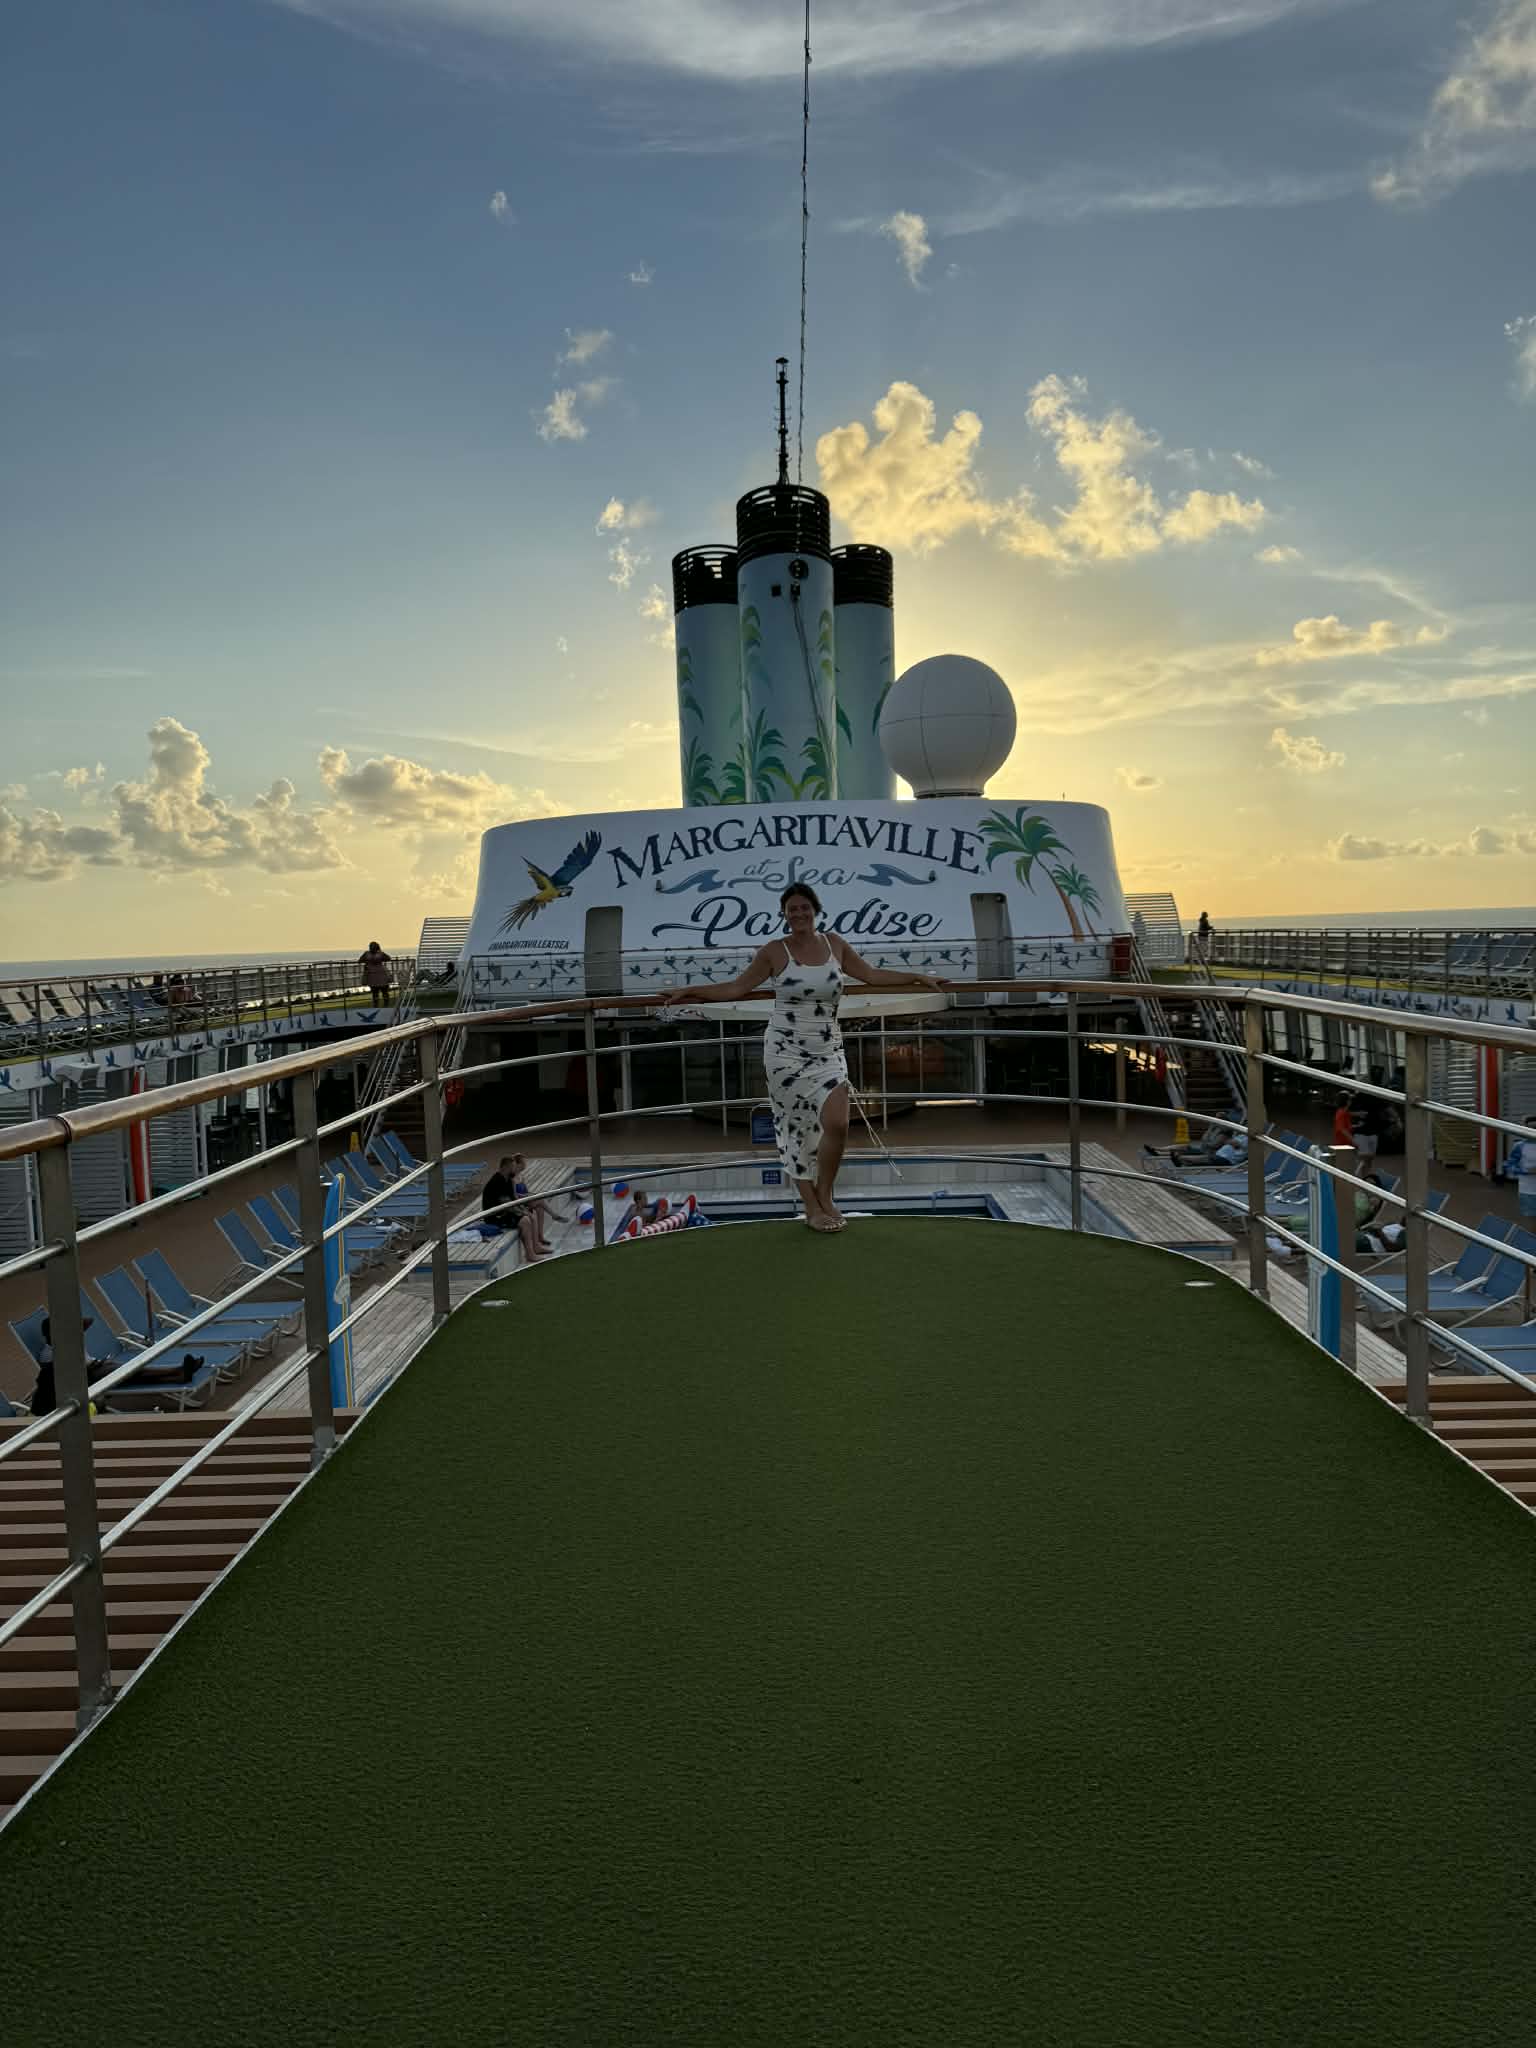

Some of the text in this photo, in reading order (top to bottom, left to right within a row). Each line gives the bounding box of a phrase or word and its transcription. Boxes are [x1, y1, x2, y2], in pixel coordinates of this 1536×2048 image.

[608, 814, 985, 888] MARGARITAVILLE
[728, 855, 856, 892] at Sea
